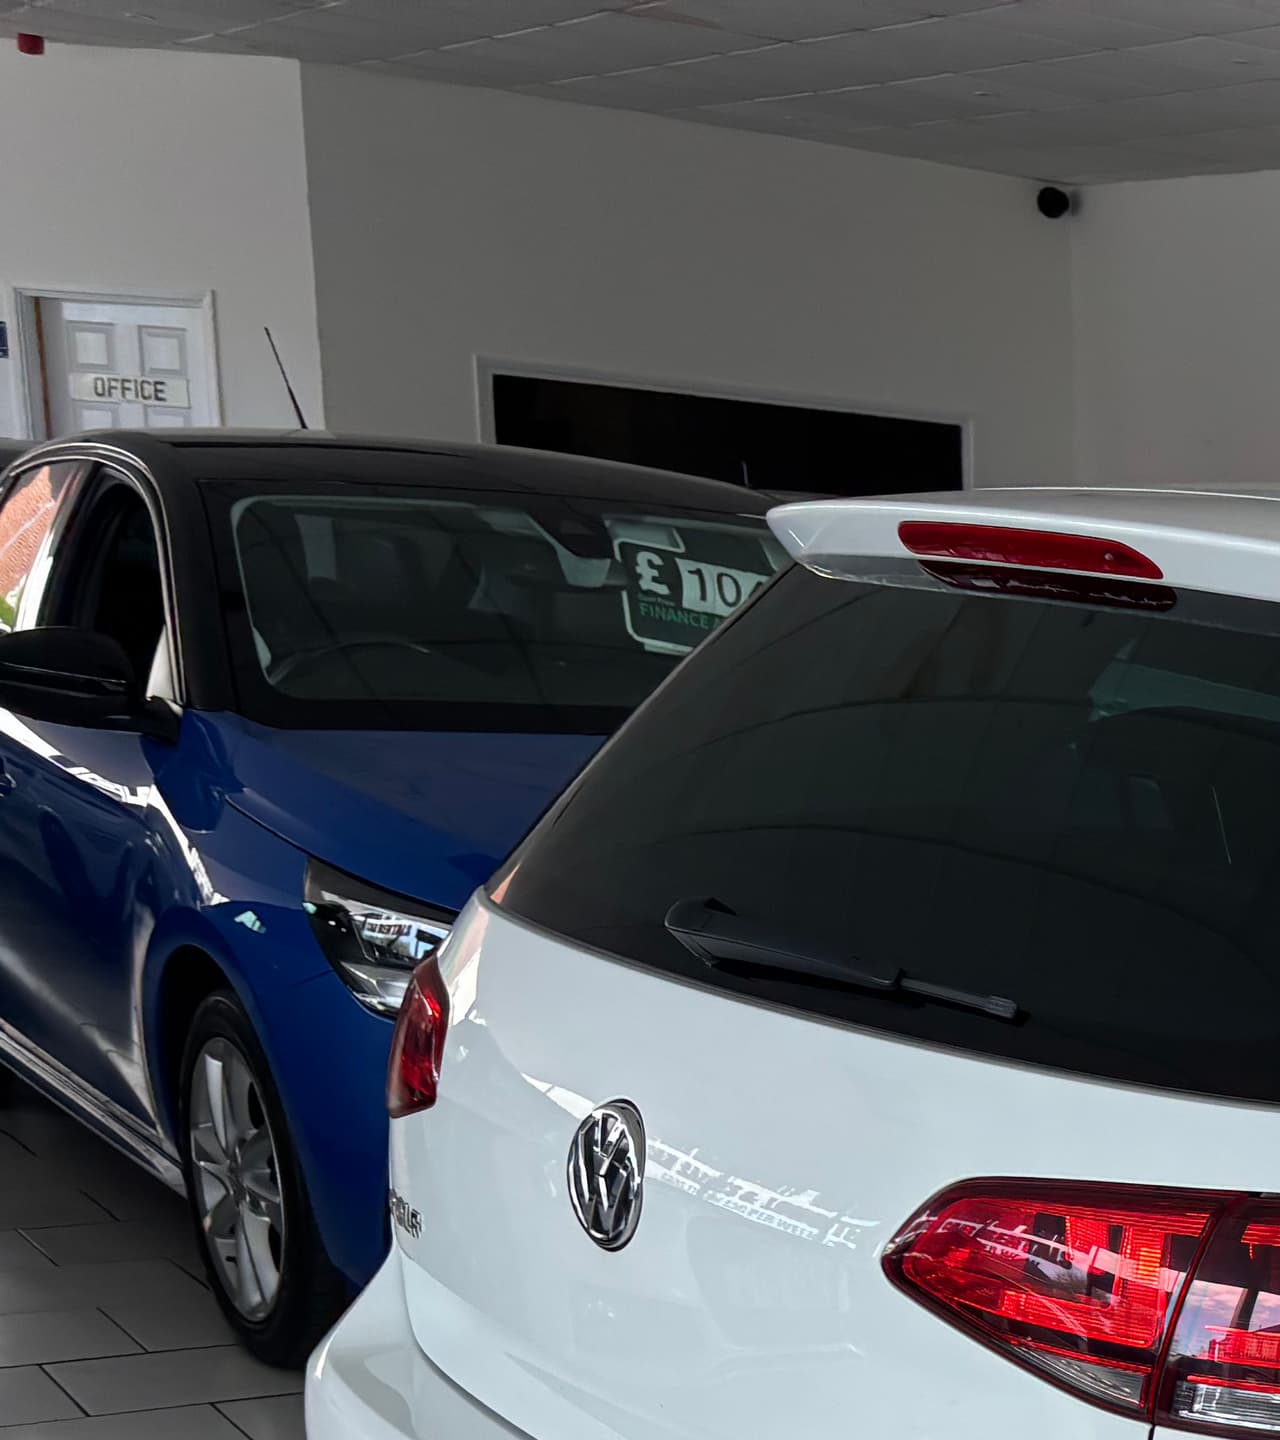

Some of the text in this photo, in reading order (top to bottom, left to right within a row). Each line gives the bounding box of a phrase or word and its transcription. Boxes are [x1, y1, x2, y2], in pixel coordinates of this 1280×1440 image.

[93, 376, 167, 402] OFFICE
[688, 567, 763, 607] 10
[639, 603, 709, 630] FINANCE
